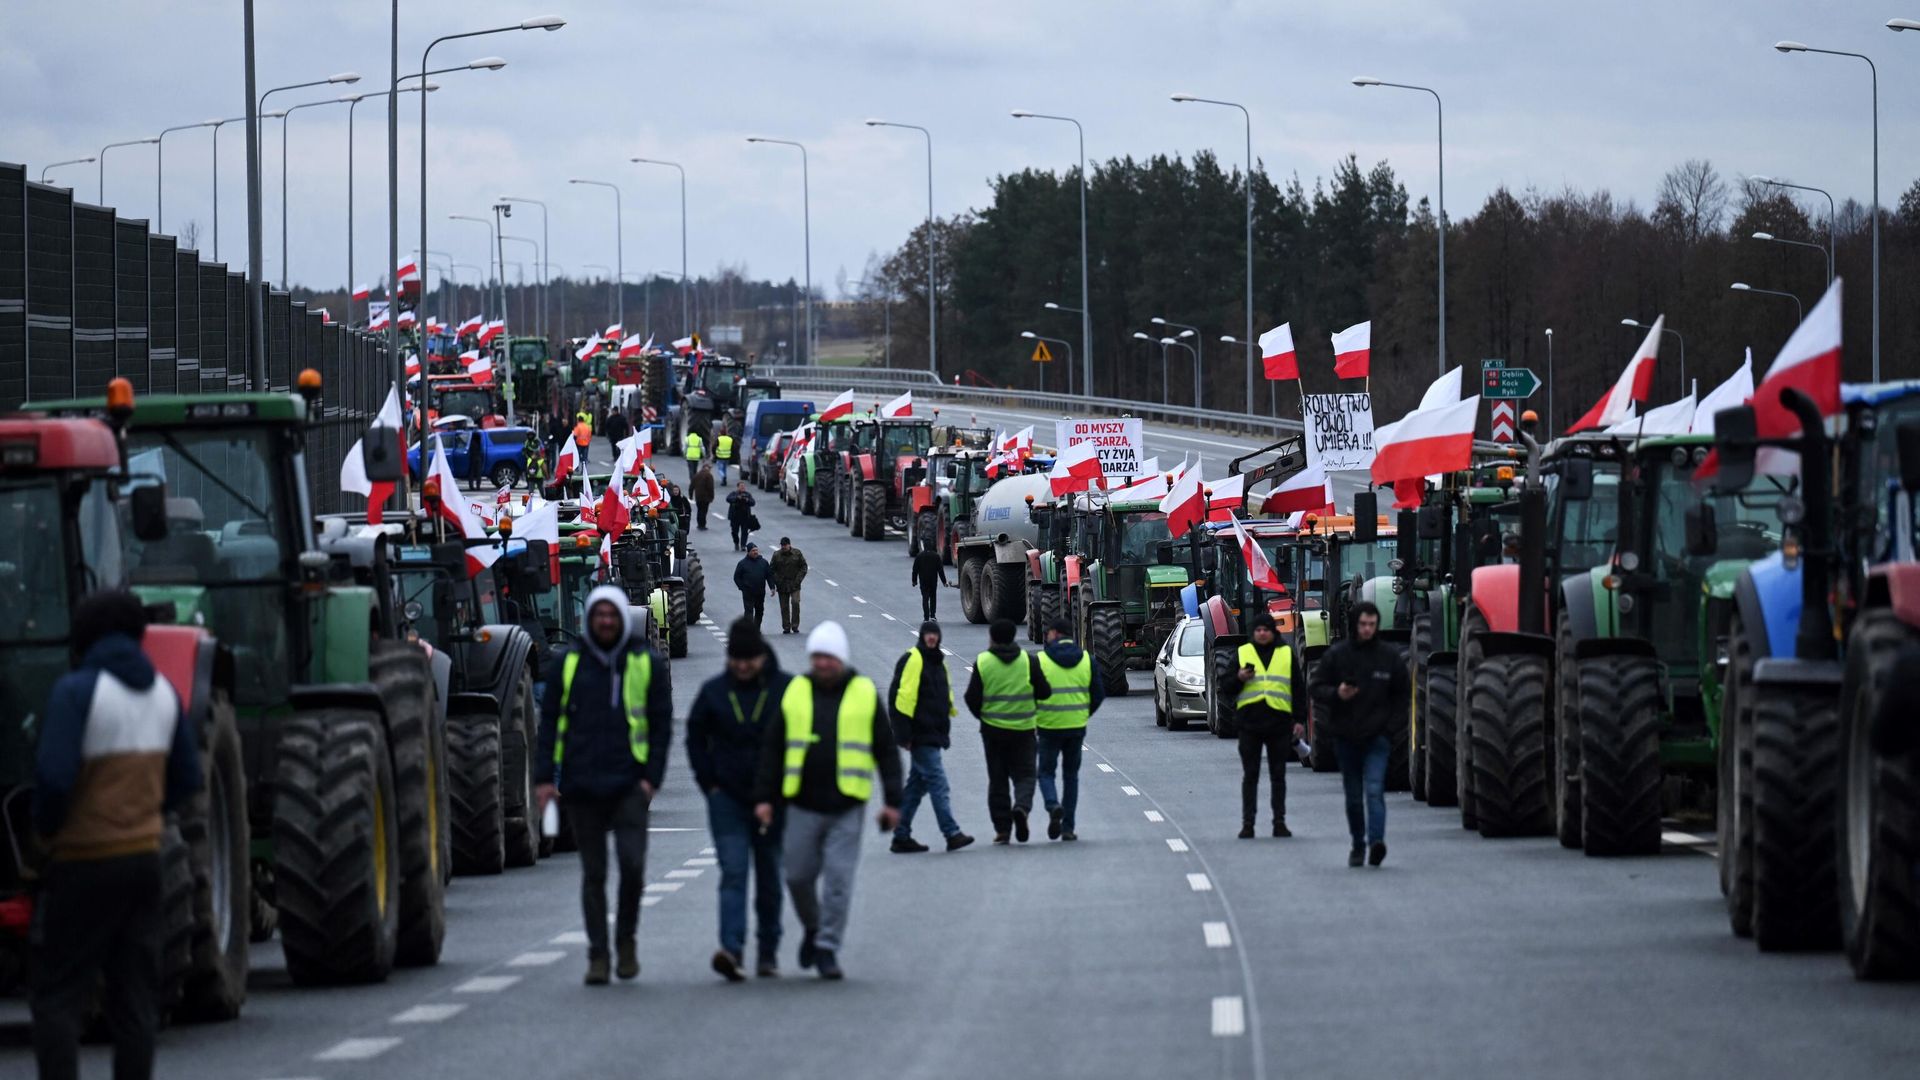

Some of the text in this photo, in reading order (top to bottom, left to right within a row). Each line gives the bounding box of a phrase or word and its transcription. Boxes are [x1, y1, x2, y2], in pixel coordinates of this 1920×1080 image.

[1304, 394, 1370, 416] ROLNICTWO
[1075, 423, 1125, 434] OD MYSZY
[1314, 413, 1353, 433] POWOLI
[1102, 462, 1139, 472] DARZA!
